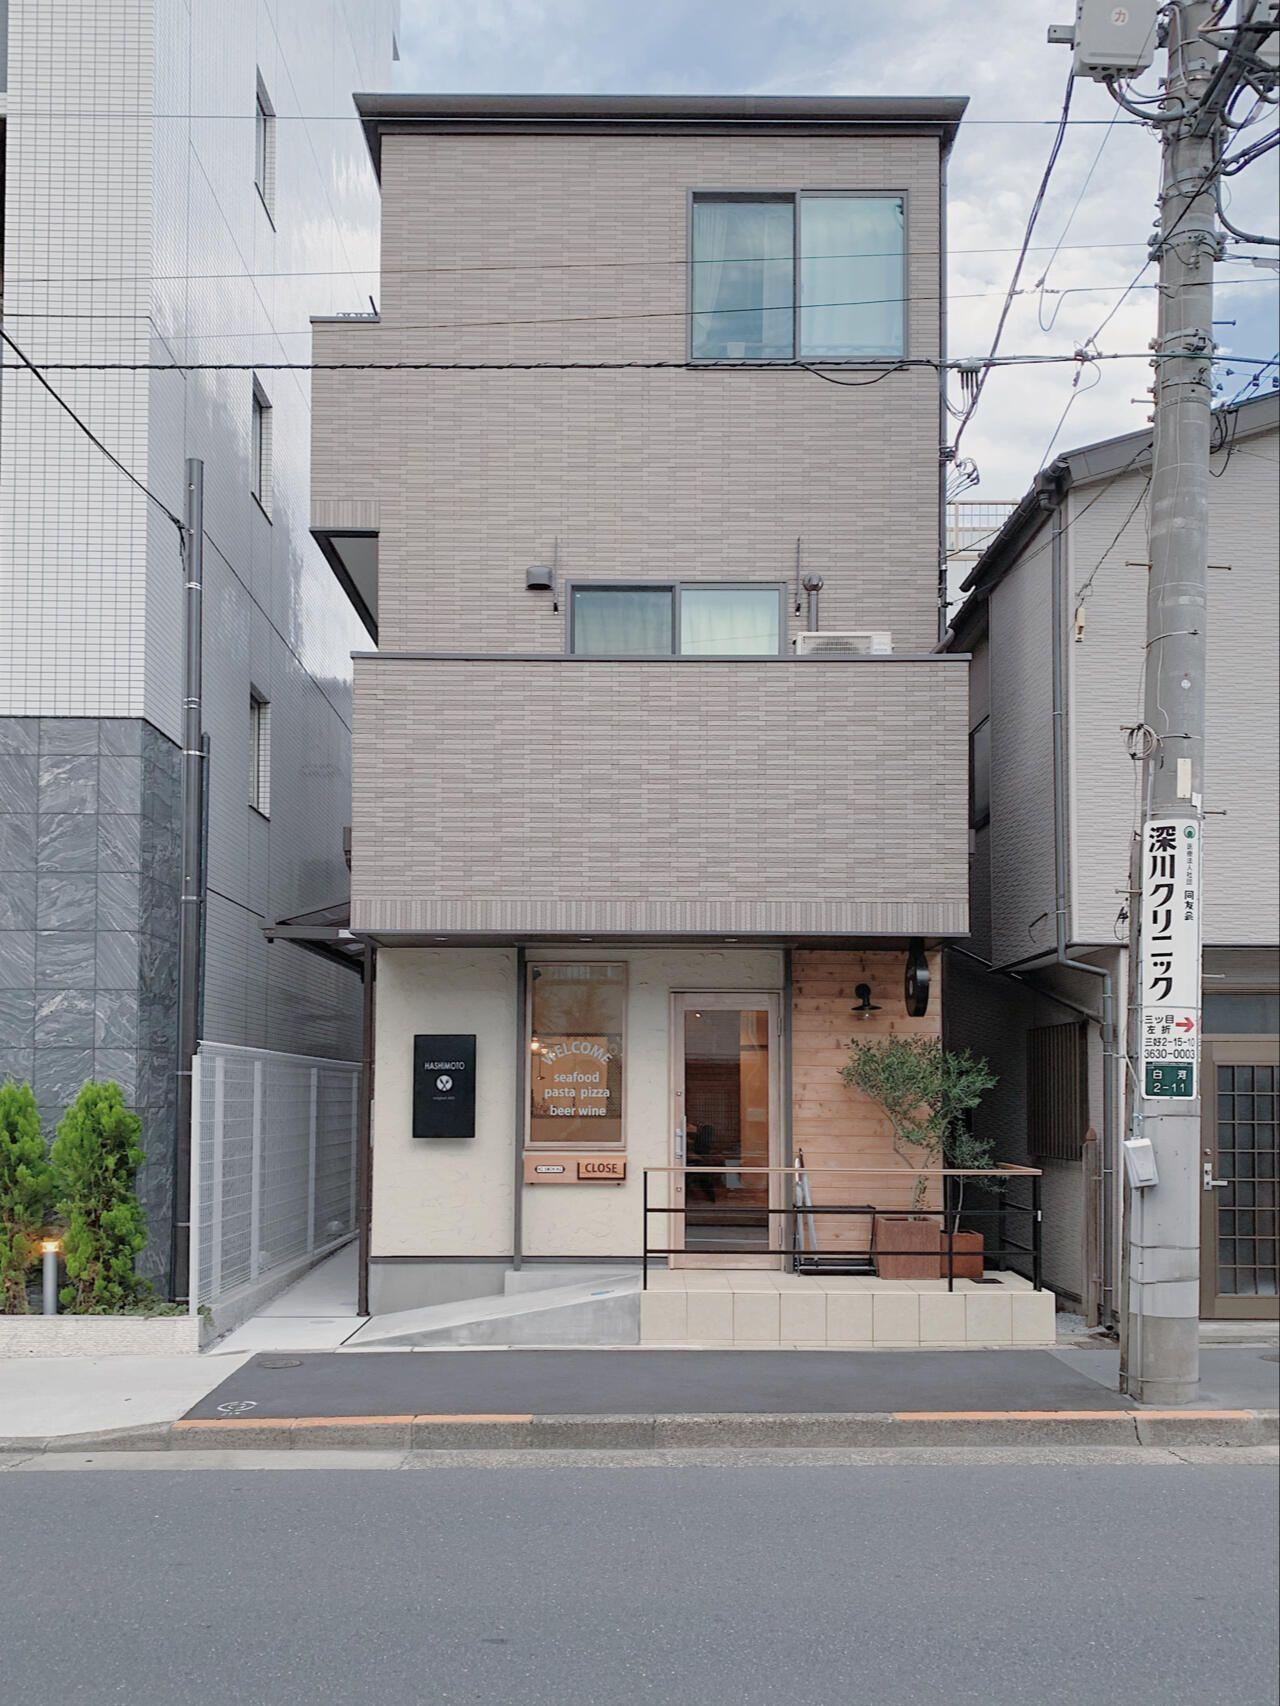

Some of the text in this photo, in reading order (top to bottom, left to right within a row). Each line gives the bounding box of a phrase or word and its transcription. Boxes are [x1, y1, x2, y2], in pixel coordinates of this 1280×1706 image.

[1148, 825, 1177, 1002] 深川クリニック
[1145, 1014, 1174, 1024] 三ツ目
[541, 1041, 613, 1065] WELCOME
[1144, 1049, 1195, 1060] 3630-0003
[424, 1061, 465, 1070] HASHIMOTO
[554, 1071, 600, 1083] seafood
[544, 1086, 610, 1099] pasta pizza
[1153, 1082, 1185, 1093] 2-11
[550, 1104, 607, 1116] beer wine
[584, 1162, 618, 1174] CLOSE
